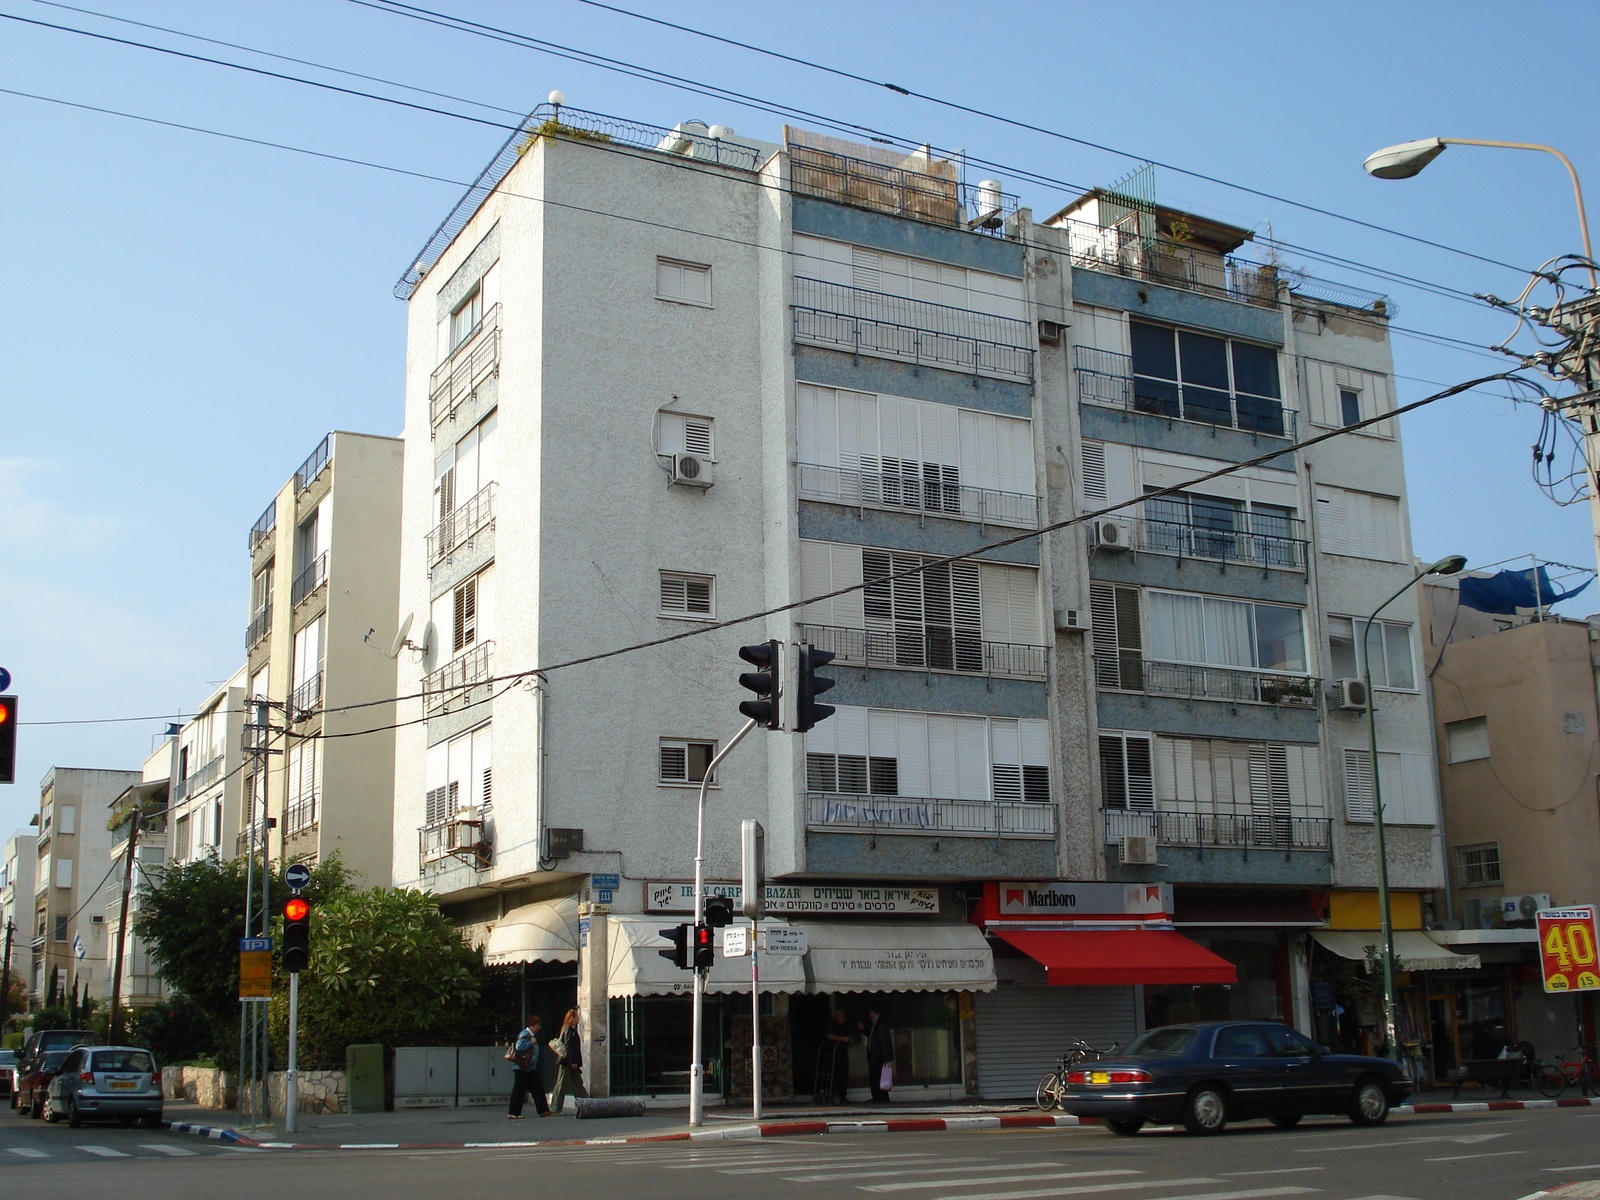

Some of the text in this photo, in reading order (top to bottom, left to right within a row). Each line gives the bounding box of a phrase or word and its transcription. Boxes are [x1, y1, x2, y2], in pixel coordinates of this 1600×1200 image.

[681, 886, 710, 897] IRN
[766, 887, 800, 898] BAZAR
[813, 888, 910, 902] איראן בזאר שטיחים
[1027, 889, 1076, 907] Marlboro
[786, 900, 823, 911] קווקזים
[831, 901, 855, 910] סינים
[864, 902, 896, 911] פרסים
[1545, 923, 1596, 967] 40
[1580, 976, 1594, 986] 15
